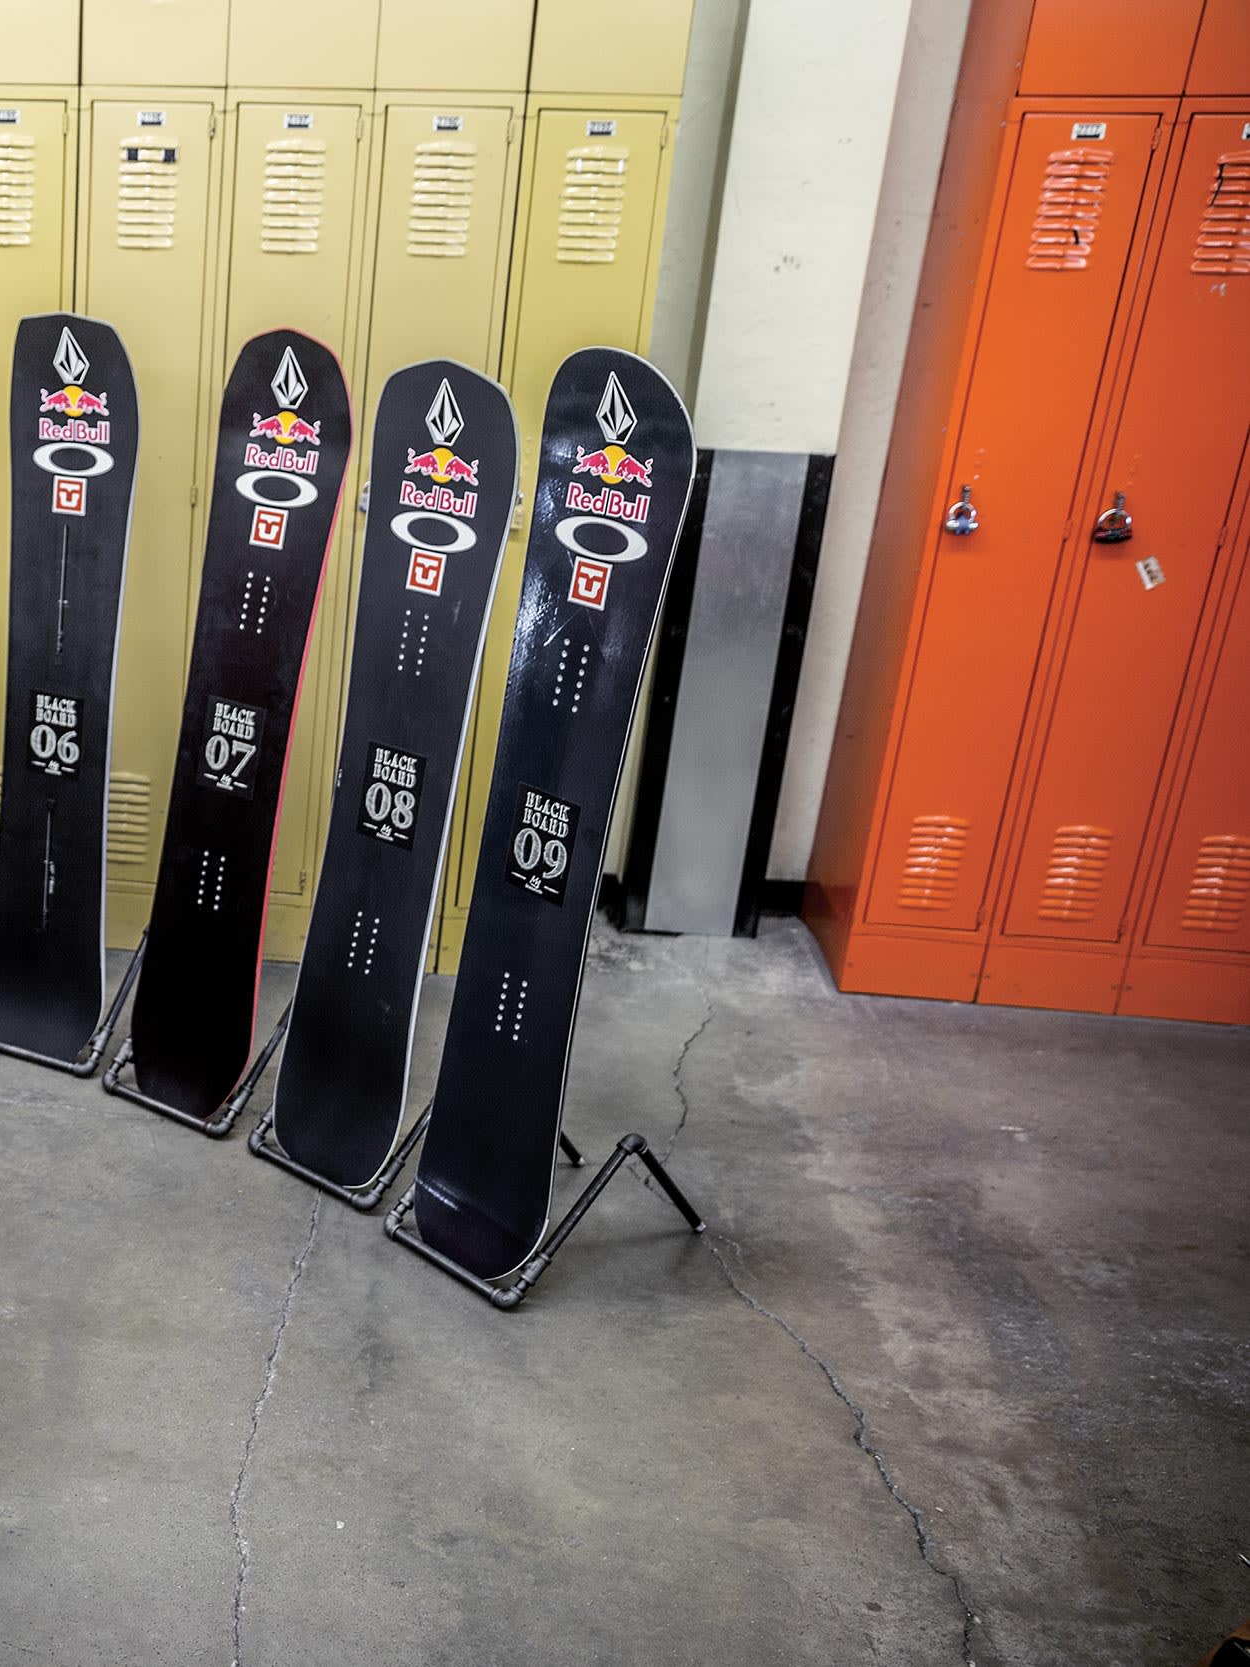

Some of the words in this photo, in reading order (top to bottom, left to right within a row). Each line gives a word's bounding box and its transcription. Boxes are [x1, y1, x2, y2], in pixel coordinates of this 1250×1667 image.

[36, 694, 76, 713] BLACK
[215, 703, 256, 725] BLACK
[35, 708, 77, 727] BOARD
[213, 717, 255, 740] BOARD
[30, 724, 79, 764] 06
[205, 735, 256, 777] 07
[375, 748, 417, 773] BLACK
[373, 763, 416, 788] BOARD
[365, 782, 415, 829] 08
[526, 792, 570, 822] BLACK
[522, 808, 569, 838] BOARD
[514, 828, 567, 879] 09
